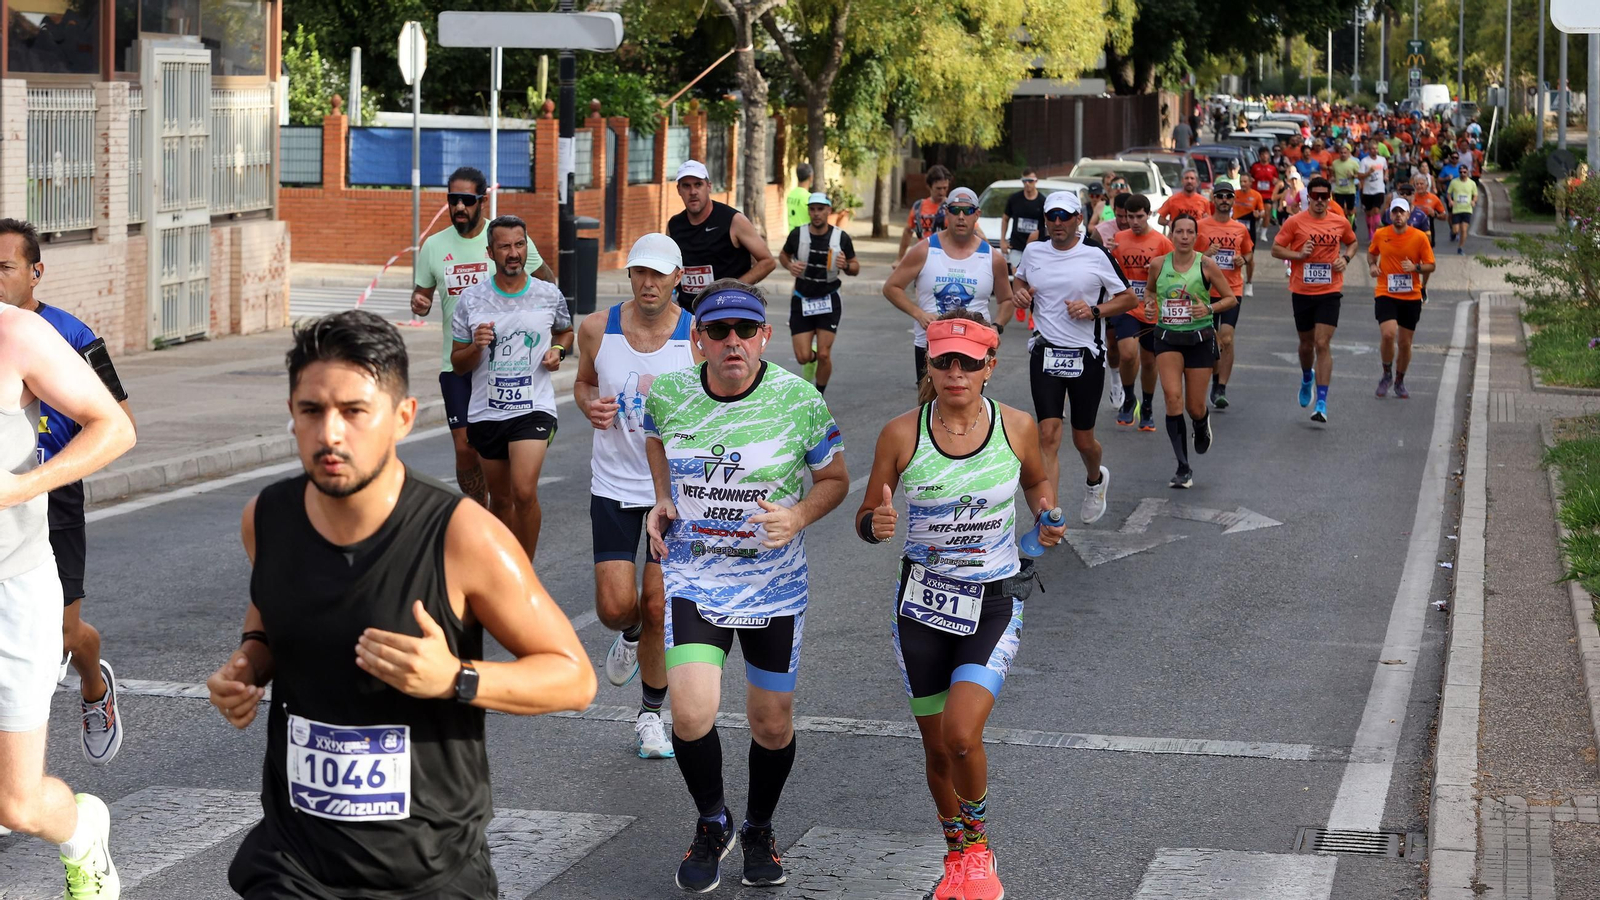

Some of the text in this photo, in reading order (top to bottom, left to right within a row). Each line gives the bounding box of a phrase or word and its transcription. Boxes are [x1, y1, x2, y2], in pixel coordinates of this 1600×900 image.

[456, 274, 478, 285] 196
[686, 276, 704, 285] 310
[935, 276, 978, 285] RUNNERS
[808, 301, 826, 309] 1130
[1168, 308, 1184, 316] 159
[1054, 359, 1074, 368] 643
[497, 389, 522, 400] 736
[683, 484, 768, 502] VETE-RUNNERS
[704, 507, 744, 521] JEREZ
[928, 518, 1002, 532] VETE-RUNNERS
[946, 535, 983, 545] JEREZ
[922, 589, 959, 614] 891
[305, 754, 386, 789] 1046
